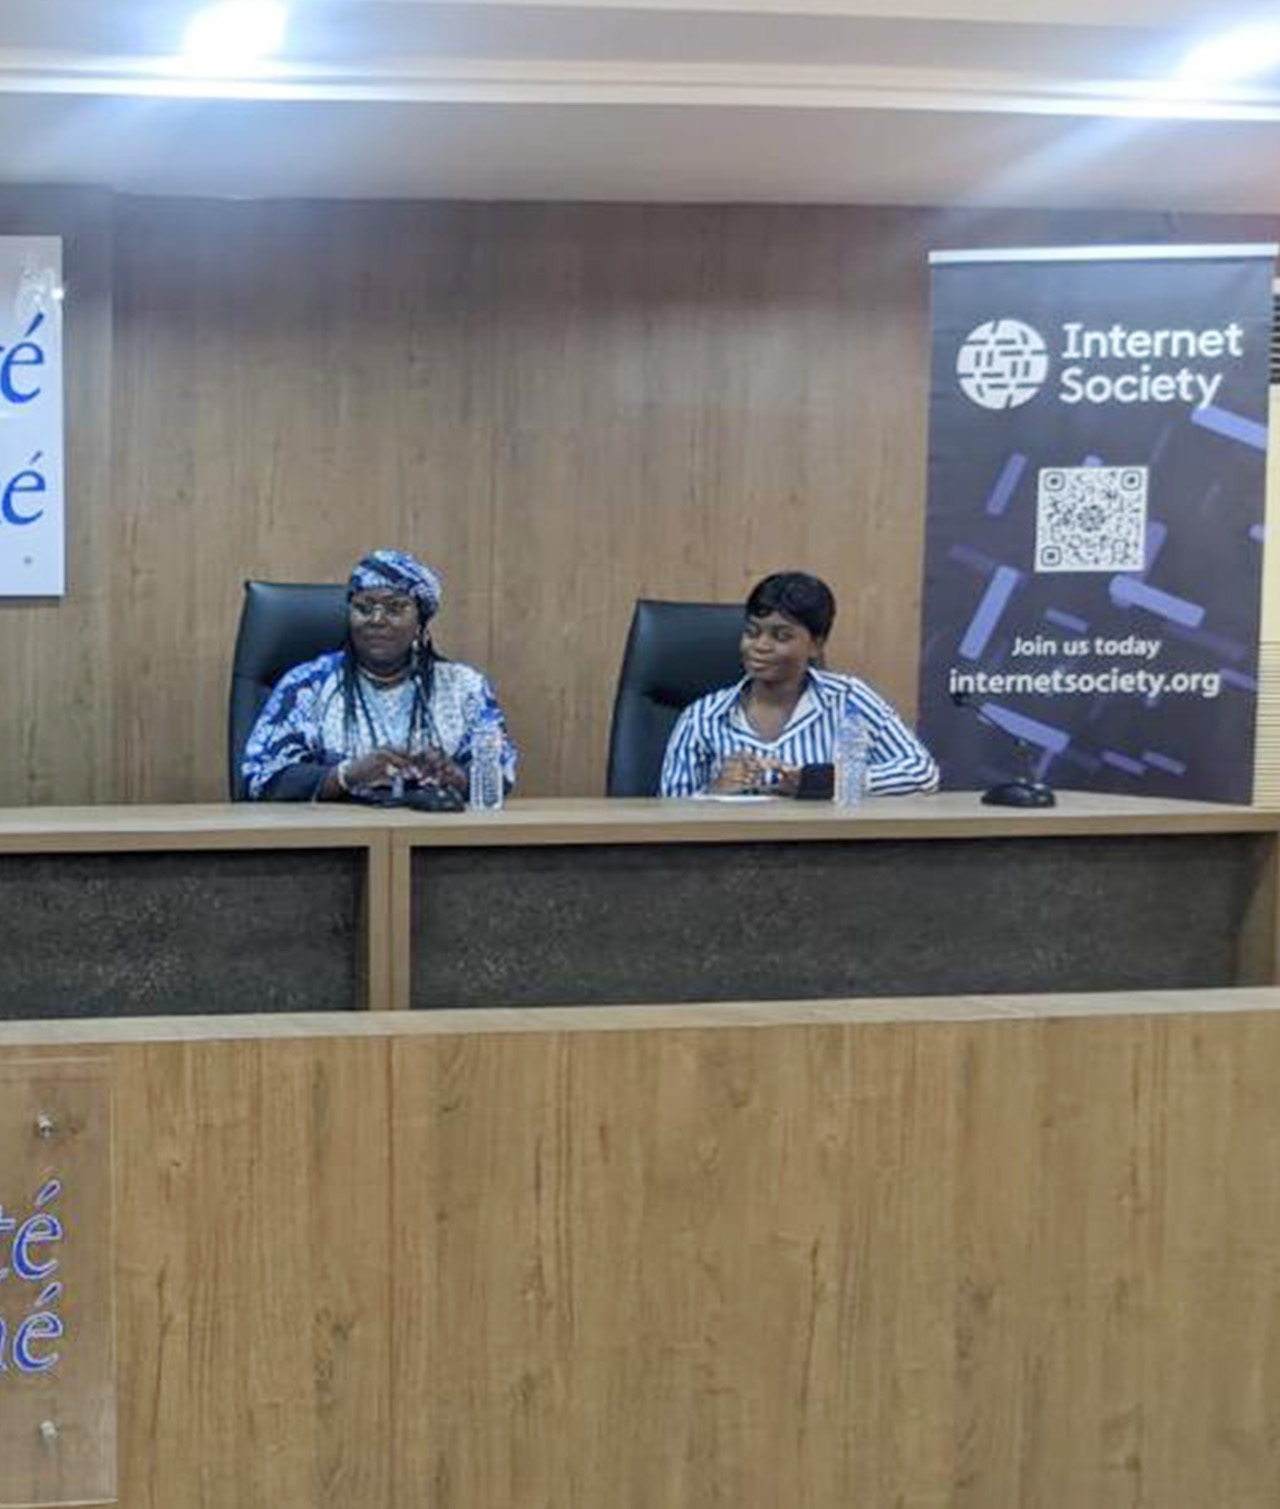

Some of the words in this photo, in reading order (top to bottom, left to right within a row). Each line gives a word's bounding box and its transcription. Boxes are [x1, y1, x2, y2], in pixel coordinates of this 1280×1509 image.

[1061, 322, 1244, 359] Internet
[1059, 363, 1223, 409] Society
[1011, 636, 1057, 656] Join
[1063, 641, 1090, 655] us
[1094, 636, 1162, 659] today
[949, 667, 1221, 698] internetsociety.org
